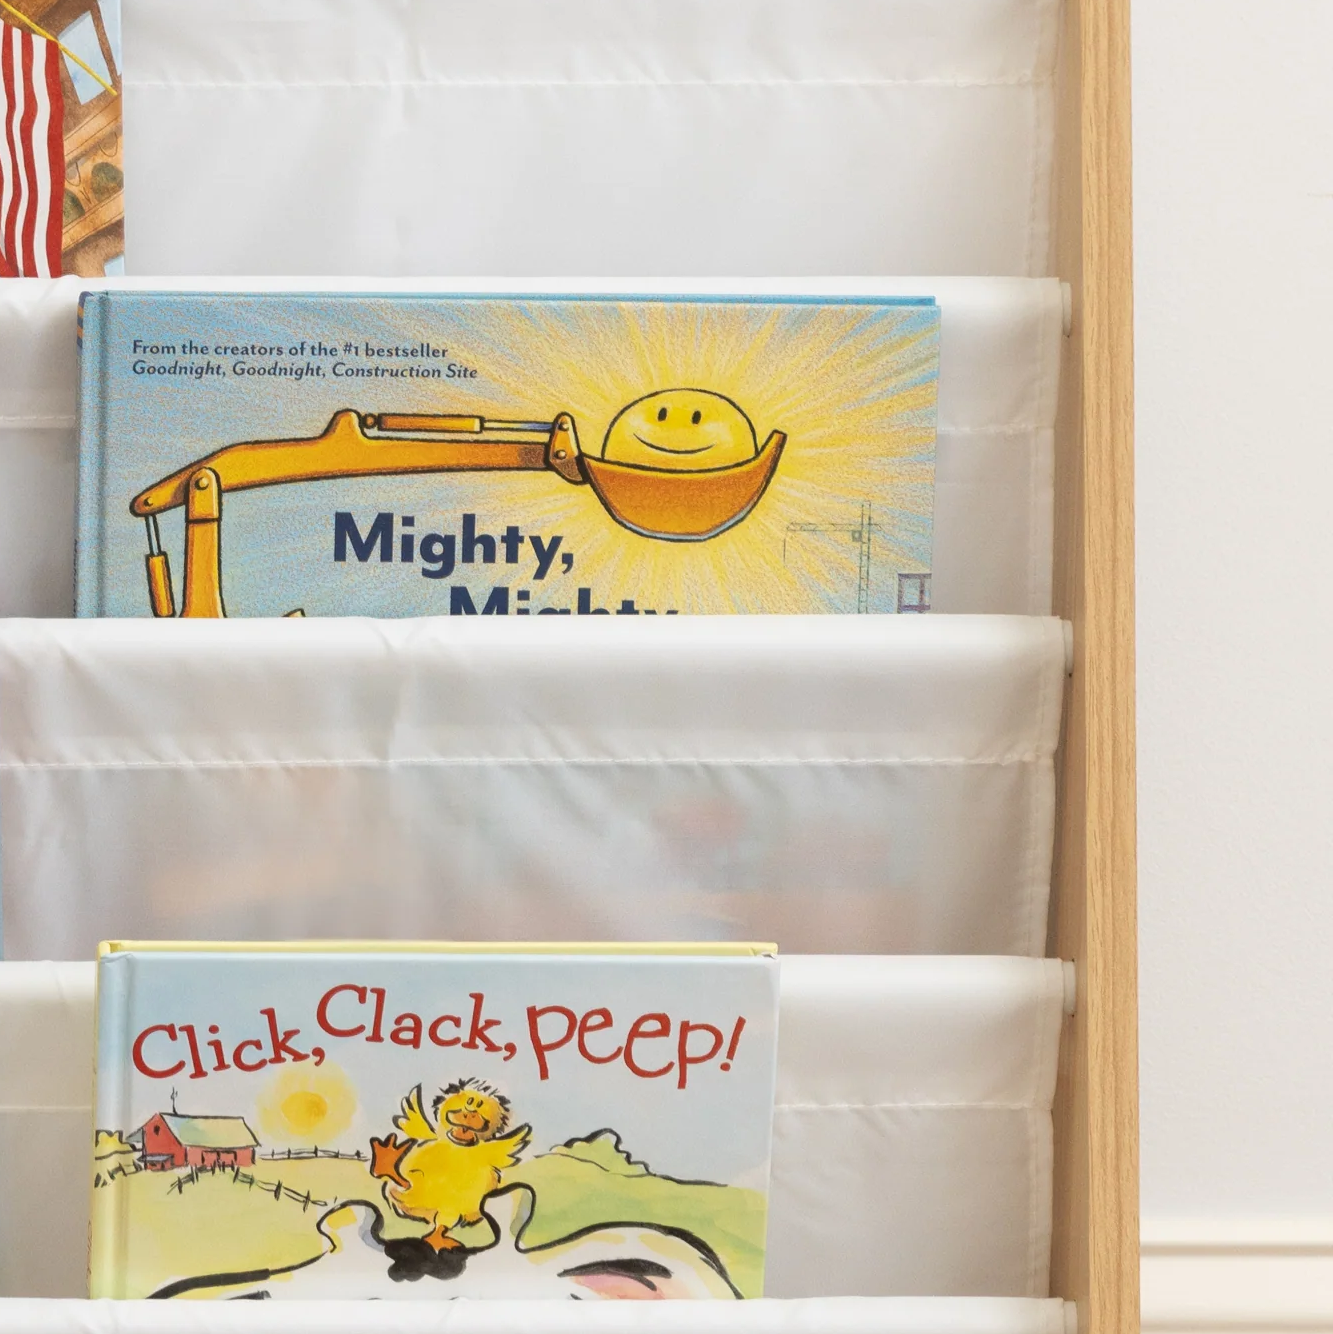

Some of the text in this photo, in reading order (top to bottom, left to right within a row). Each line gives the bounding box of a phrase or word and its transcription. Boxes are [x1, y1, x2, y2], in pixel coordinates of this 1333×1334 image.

[132, 340, 449, 359] From the creators of the #1 bestseller
[132, 359, 478, 381] Goodnight, Goodnight, Construction Site
[333, 511, 574, 580] Mighty,
[131, 1007, 326, 1080] Click,
[315, 983, 518, 1062] Clack,
